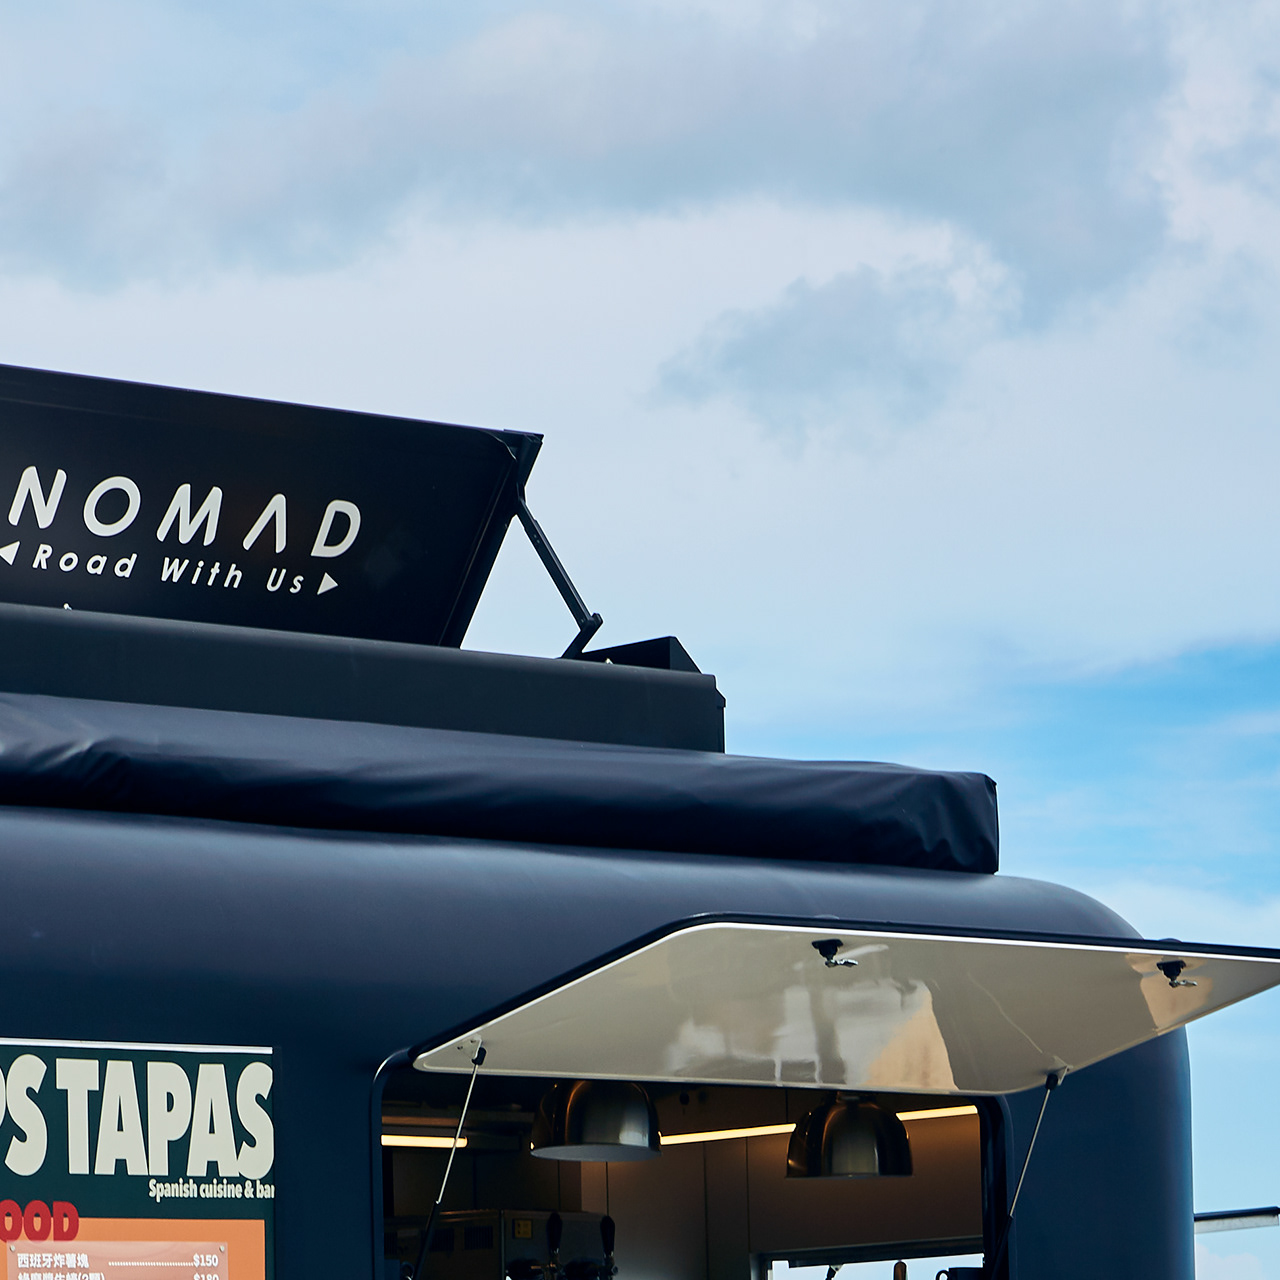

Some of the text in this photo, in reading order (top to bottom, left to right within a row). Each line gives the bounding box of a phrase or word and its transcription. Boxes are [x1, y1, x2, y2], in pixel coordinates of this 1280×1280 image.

[7, 465, 362, 559] NOMAD
[31, 543, 304, 594] Road With Us
[55, 1057, 275, 1180] TAPAS
[148, 1177, 198, 1203] Spanish
[199, 1178, 243, 1199] cuisine
[244, 1180, 255, 1199] &
[17, 1253, 219, 1268] 西班牙炸薯塊 $150
